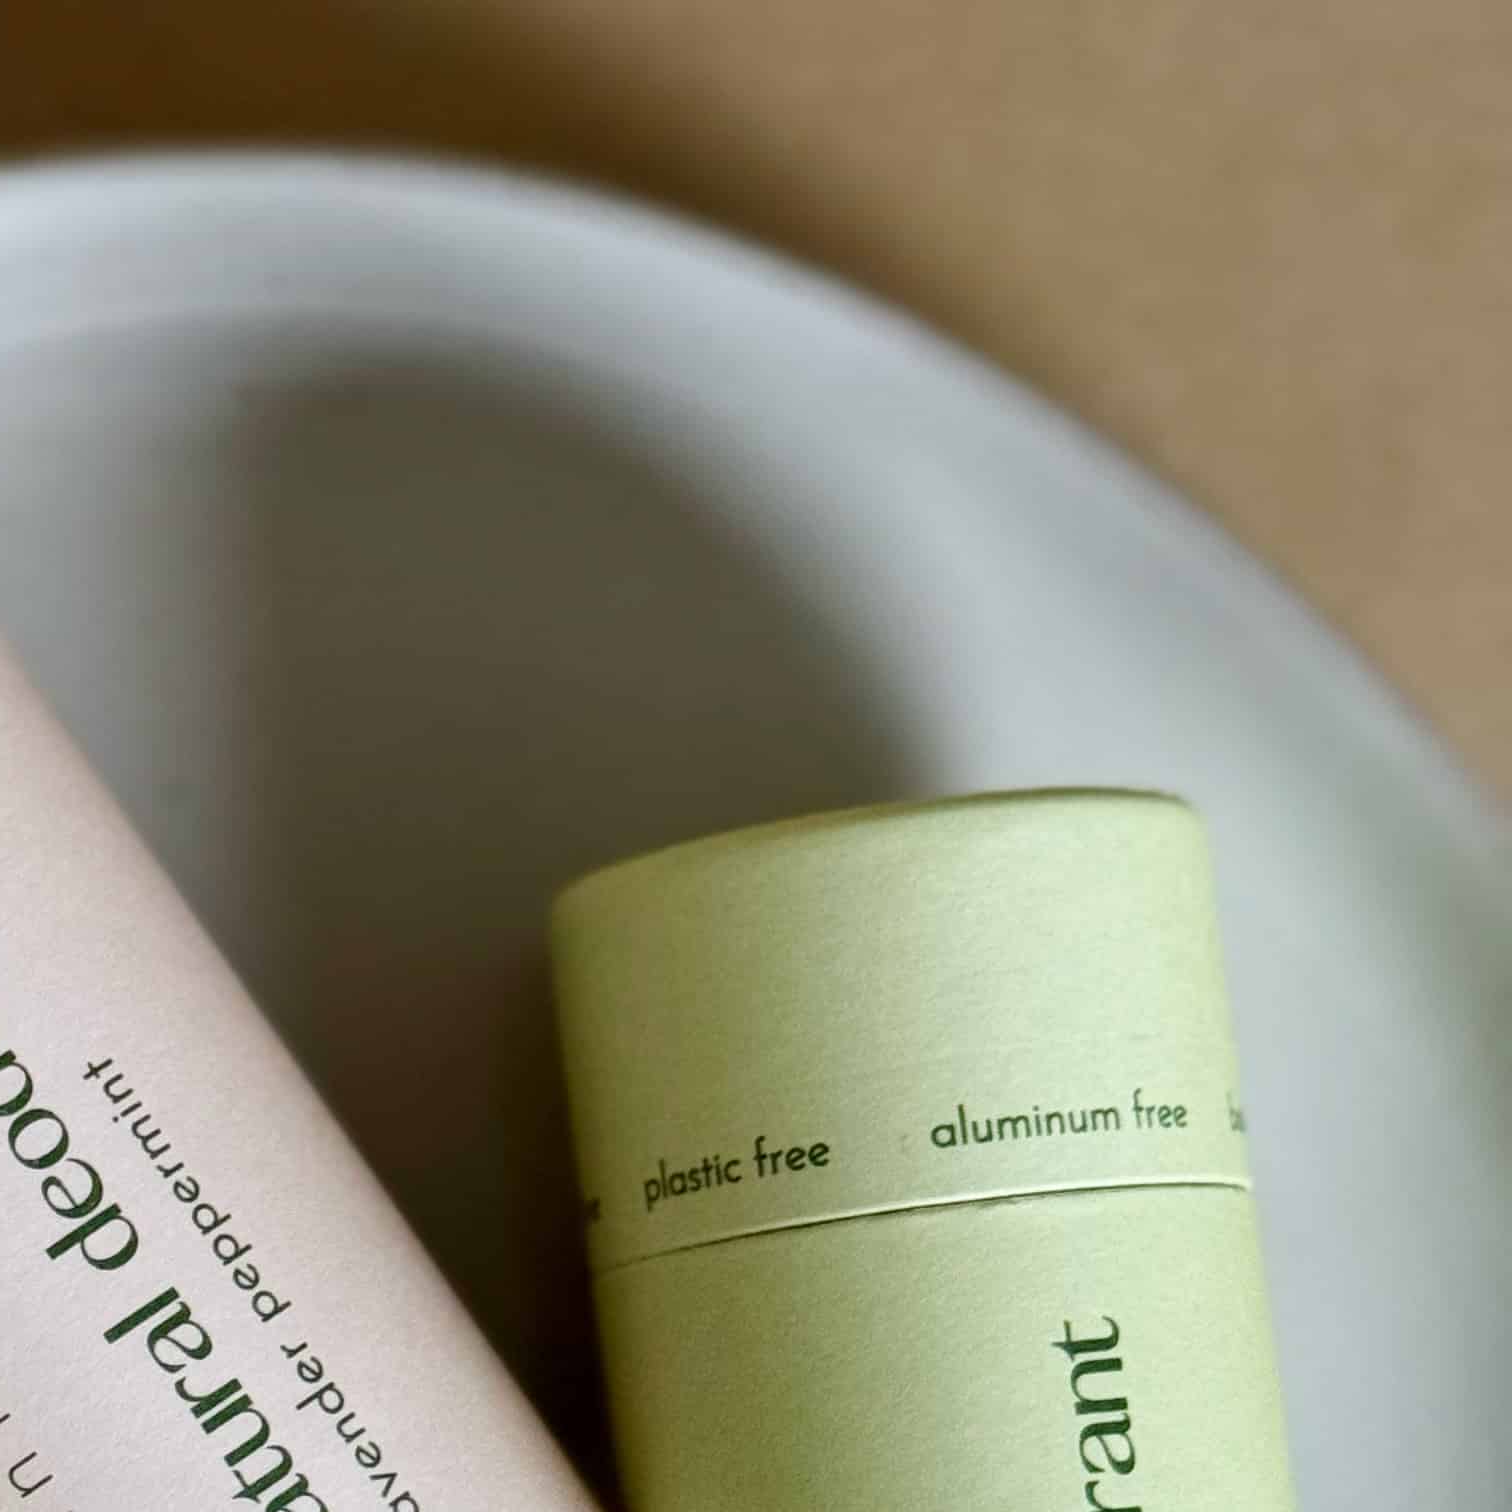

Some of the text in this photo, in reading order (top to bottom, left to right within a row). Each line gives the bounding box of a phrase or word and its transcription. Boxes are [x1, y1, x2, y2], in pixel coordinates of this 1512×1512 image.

[83, 1057, 293, 1323] peppermint
[643, 1154, 743, 1214] plastic
[753, 1135, 831, 1179] free
[931, 1103, 1122, 1149] aluminum
[1132, 1088, 1189, 1131] free
